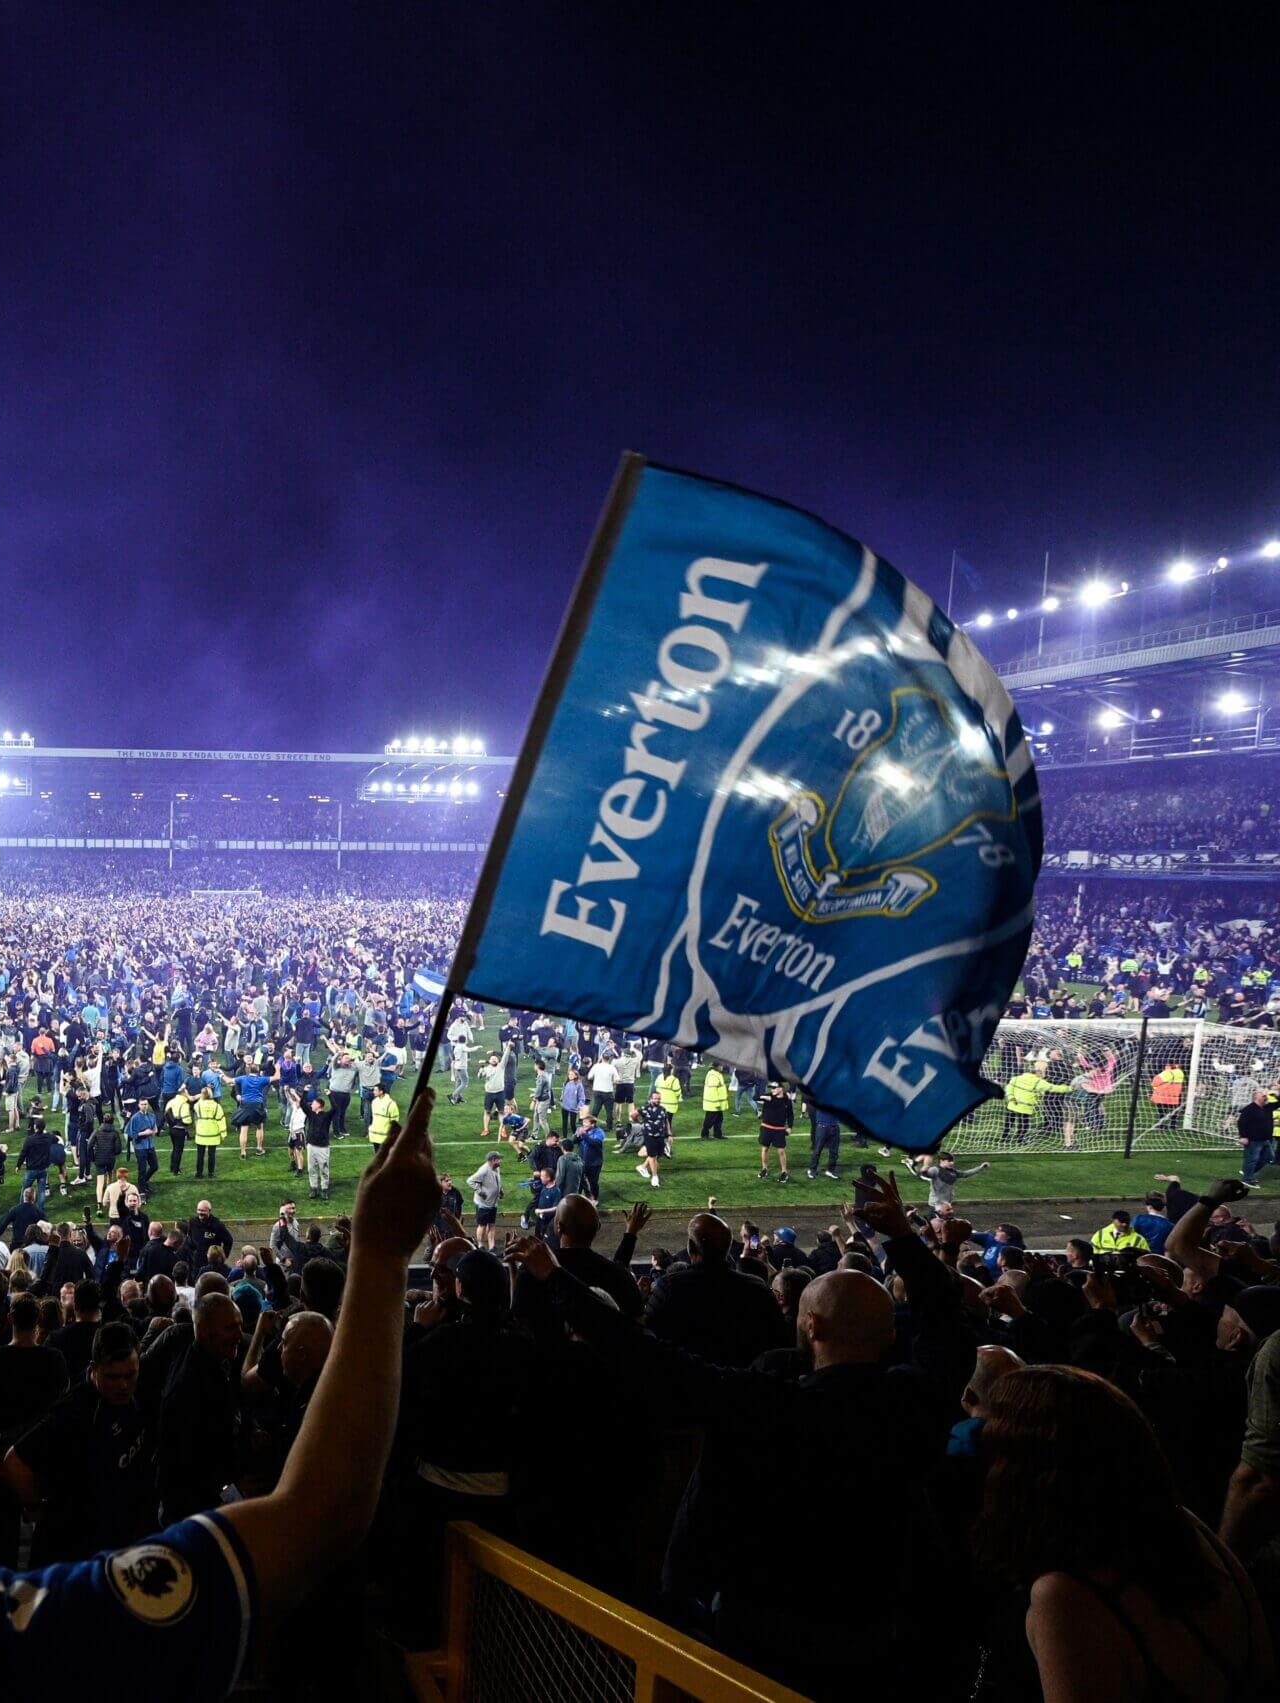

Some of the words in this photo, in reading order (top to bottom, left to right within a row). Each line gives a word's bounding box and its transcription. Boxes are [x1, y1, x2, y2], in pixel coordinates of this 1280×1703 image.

[832, 708, 882, 751] 18
[117, 750, 133, 758] THE
[138, 751, 177, 759] HOWARD
[228, 752, 271, 760] GWLADYS
[275, 753, 308, 761] STREET
[540, 557, 769, 959] Everton
[952, 822, 1016, 867] 78
